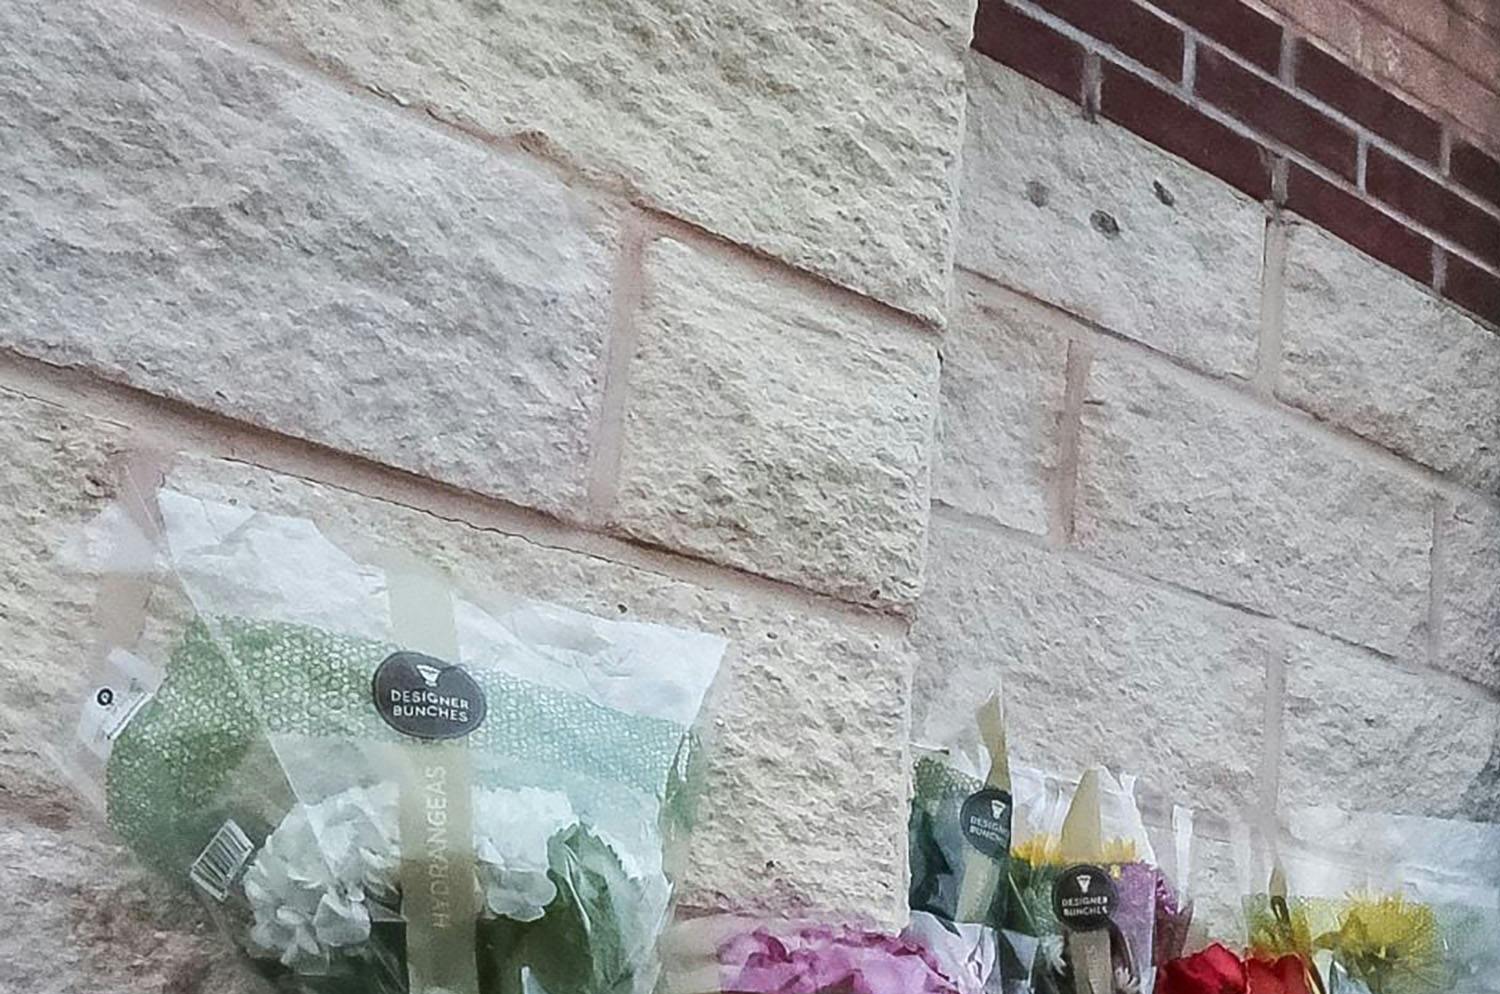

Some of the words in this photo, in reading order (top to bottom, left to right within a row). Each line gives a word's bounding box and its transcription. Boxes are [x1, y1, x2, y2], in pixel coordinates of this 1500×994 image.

[390, 689, 469, 710] DESIGNER
[392, 705, 469, 723] BUNCHES
[425, 765, 451, 929] HYDRANGEAS
